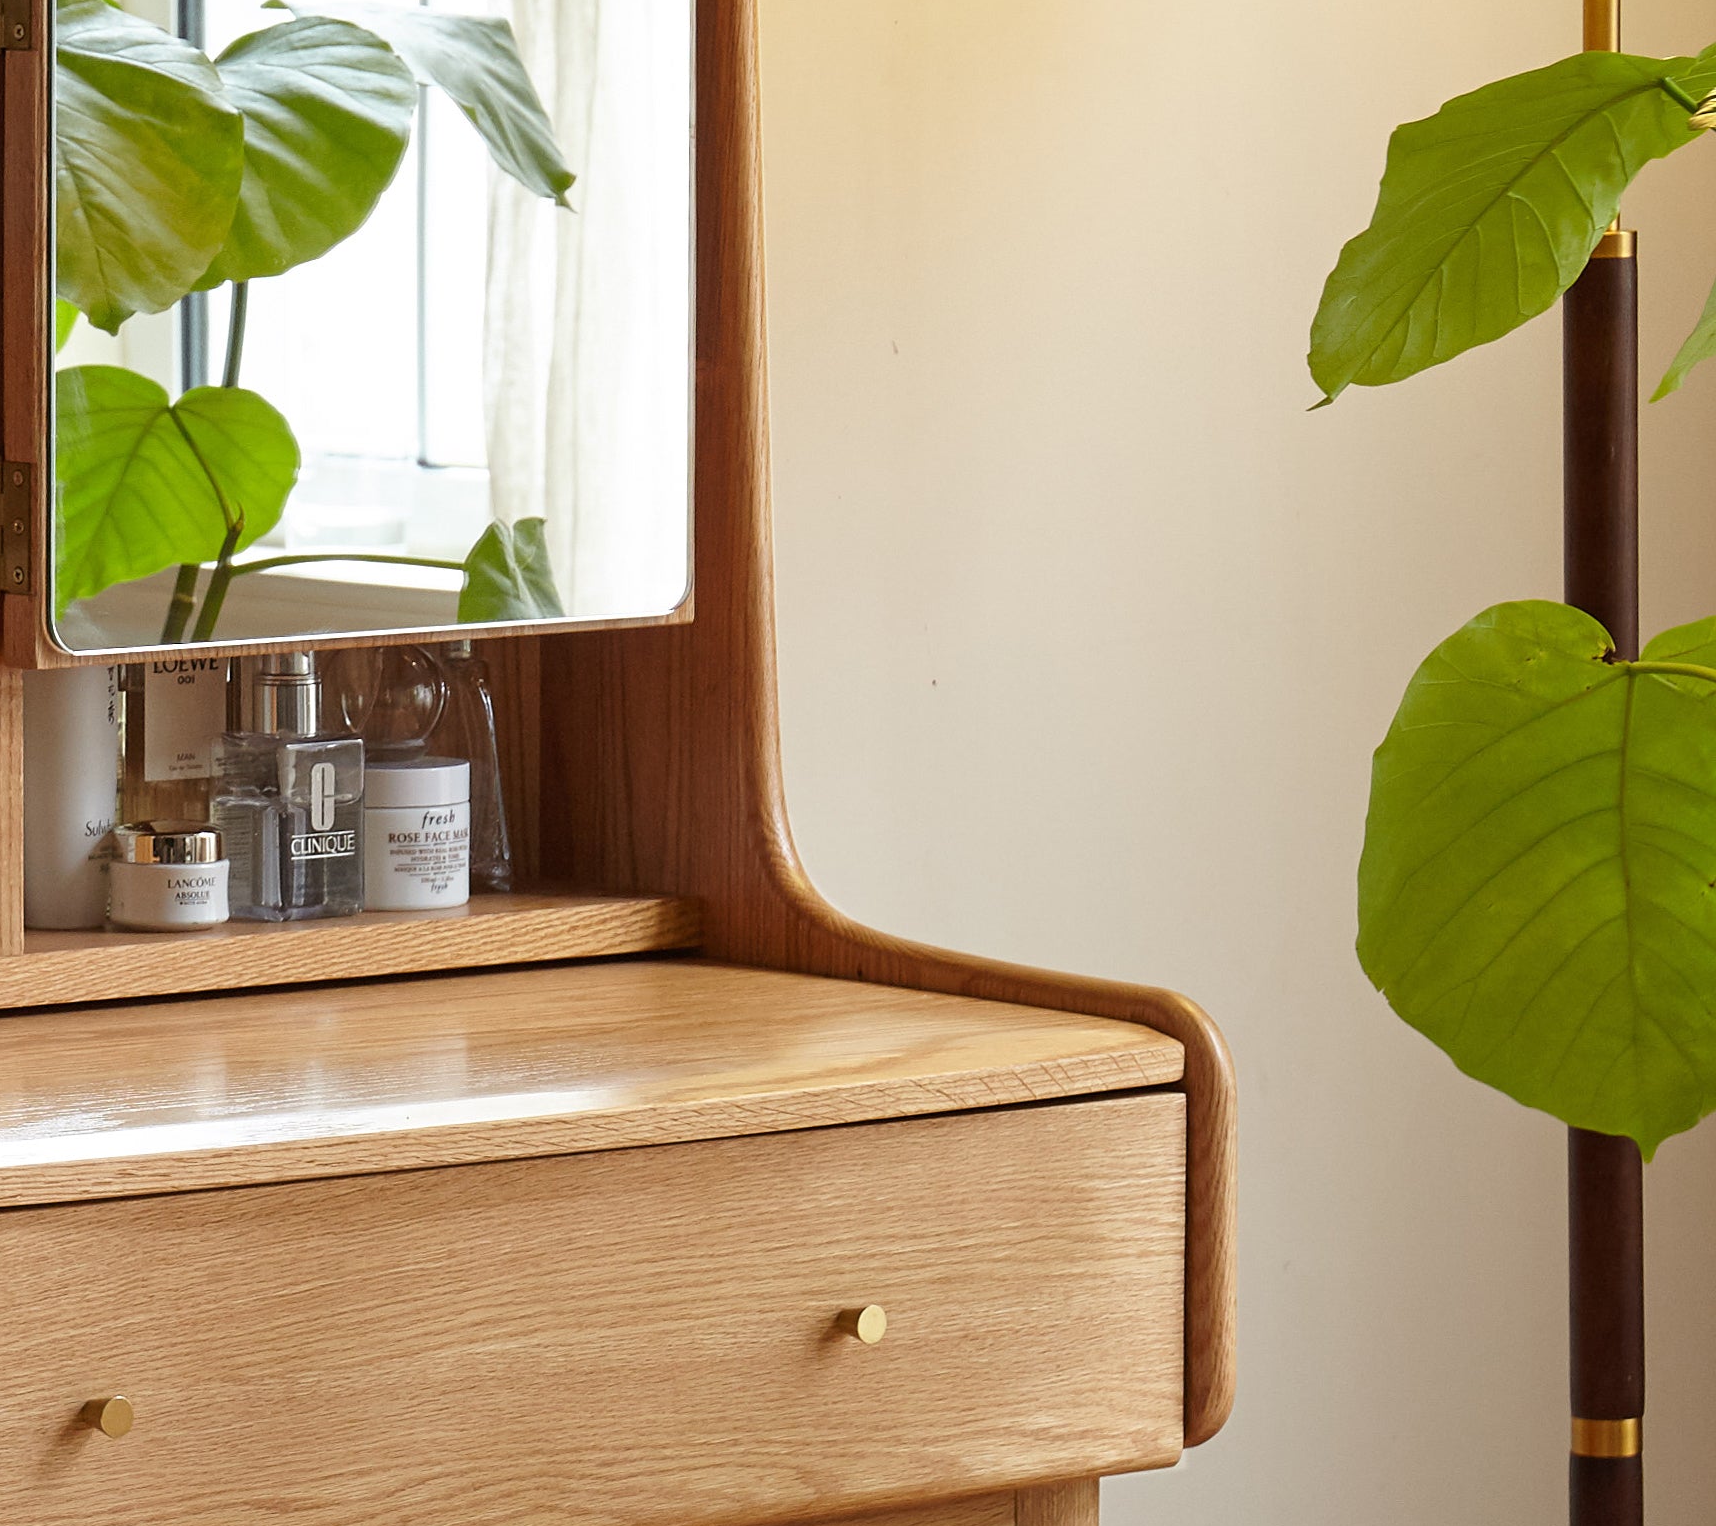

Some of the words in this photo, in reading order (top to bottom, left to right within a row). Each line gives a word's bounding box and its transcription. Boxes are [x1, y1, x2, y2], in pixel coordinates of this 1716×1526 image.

[153, 658, 219, 674] LOEWE
[177, 675, 196, 685] 001
[421, 808, 456, 830] fresh
[388, 832, 421, 844] ROSE
[424, 830, 451, 843] FACE
[291, 834, 356, 856] CLINIQUE
[167, 877, 216, 889] LANCÔME
